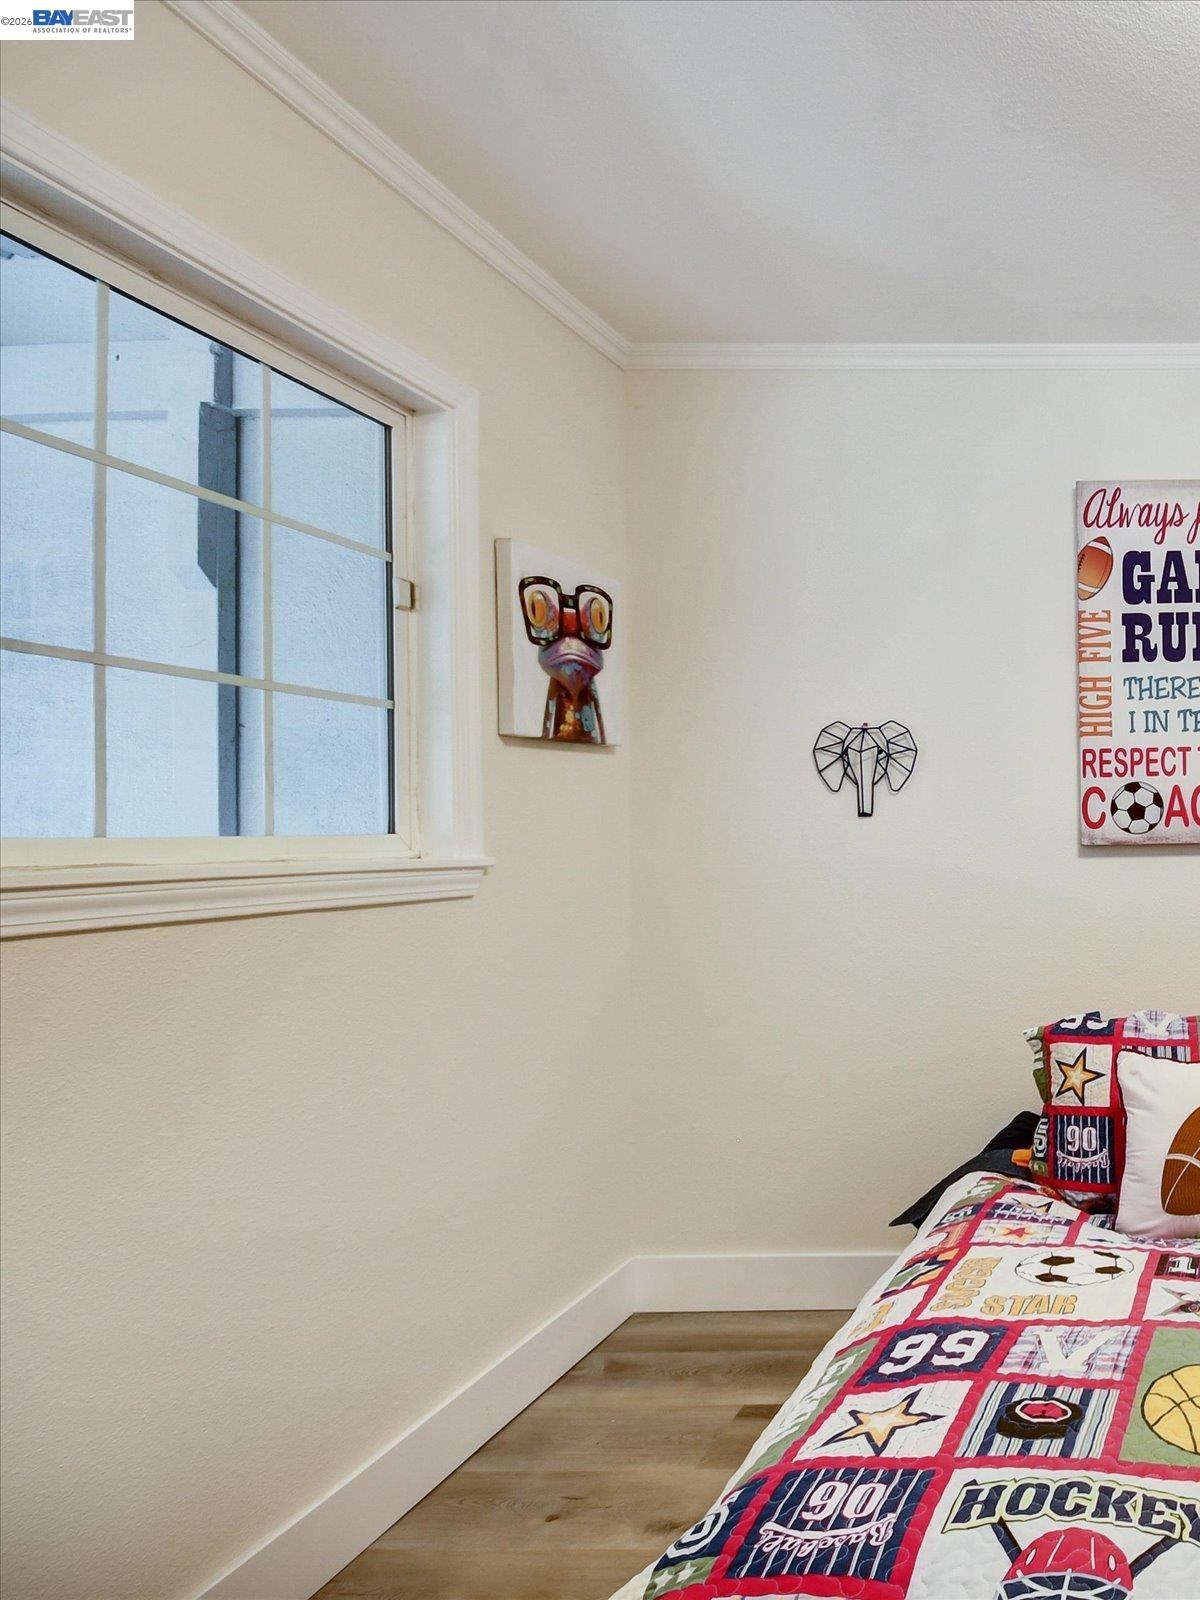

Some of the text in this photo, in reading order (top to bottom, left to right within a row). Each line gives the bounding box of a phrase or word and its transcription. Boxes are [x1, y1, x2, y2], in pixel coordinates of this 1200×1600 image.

[1083, 487, 1190, 544] Always
[1077, 609, 1113, 738] HIGH FIVE
[1128, 711, 1136, 733] I
[1144, 710, 1169, 732] IN
[1082, 747, 1191, 778] RESPECT
[1067, 1125, 1097, 1151] 90
[980, 1294, 1077, 1317] STAR
[877, 1330, 993, 1375] 99
[801, 1481, 887, 1521] 90
